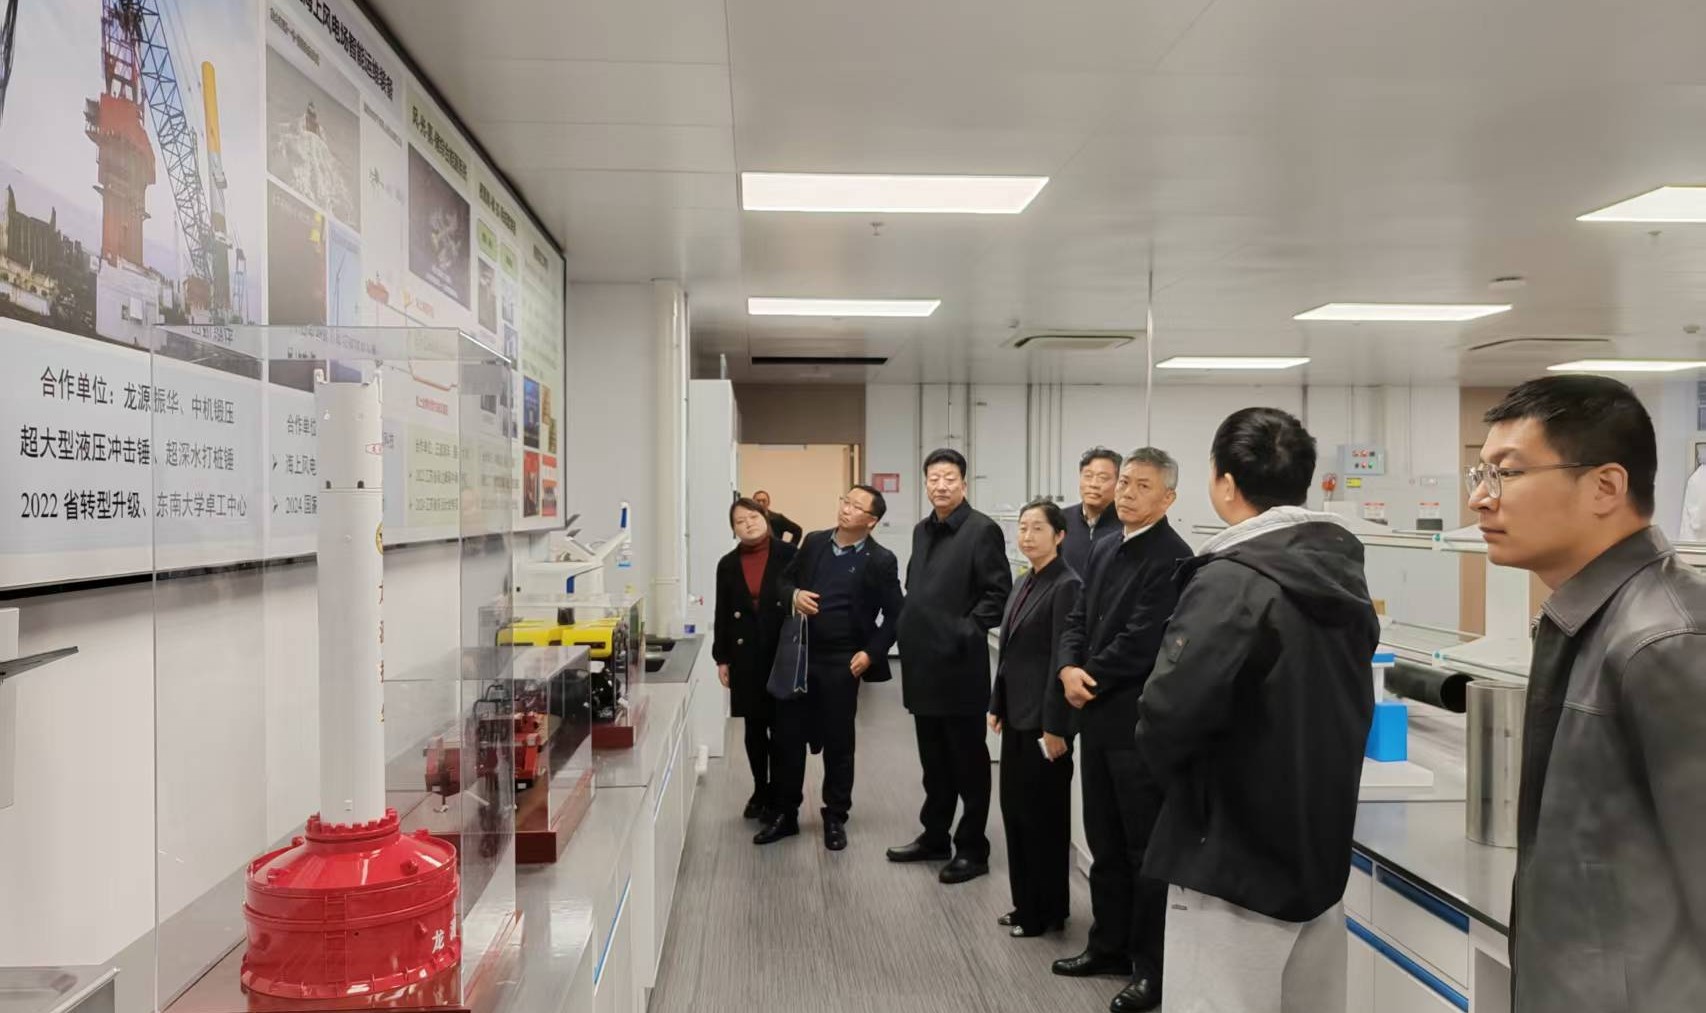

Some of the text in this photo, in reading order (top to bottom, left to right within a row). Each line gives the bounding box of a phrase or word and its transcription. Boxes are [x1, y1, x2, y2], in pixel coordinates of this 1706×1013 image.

[20, 424, 235, 471] 超大型液压冲击锤、超深水打桩锤
[21, 492, 58, 518] 2022
[432, 929, 445, 954] 龙
